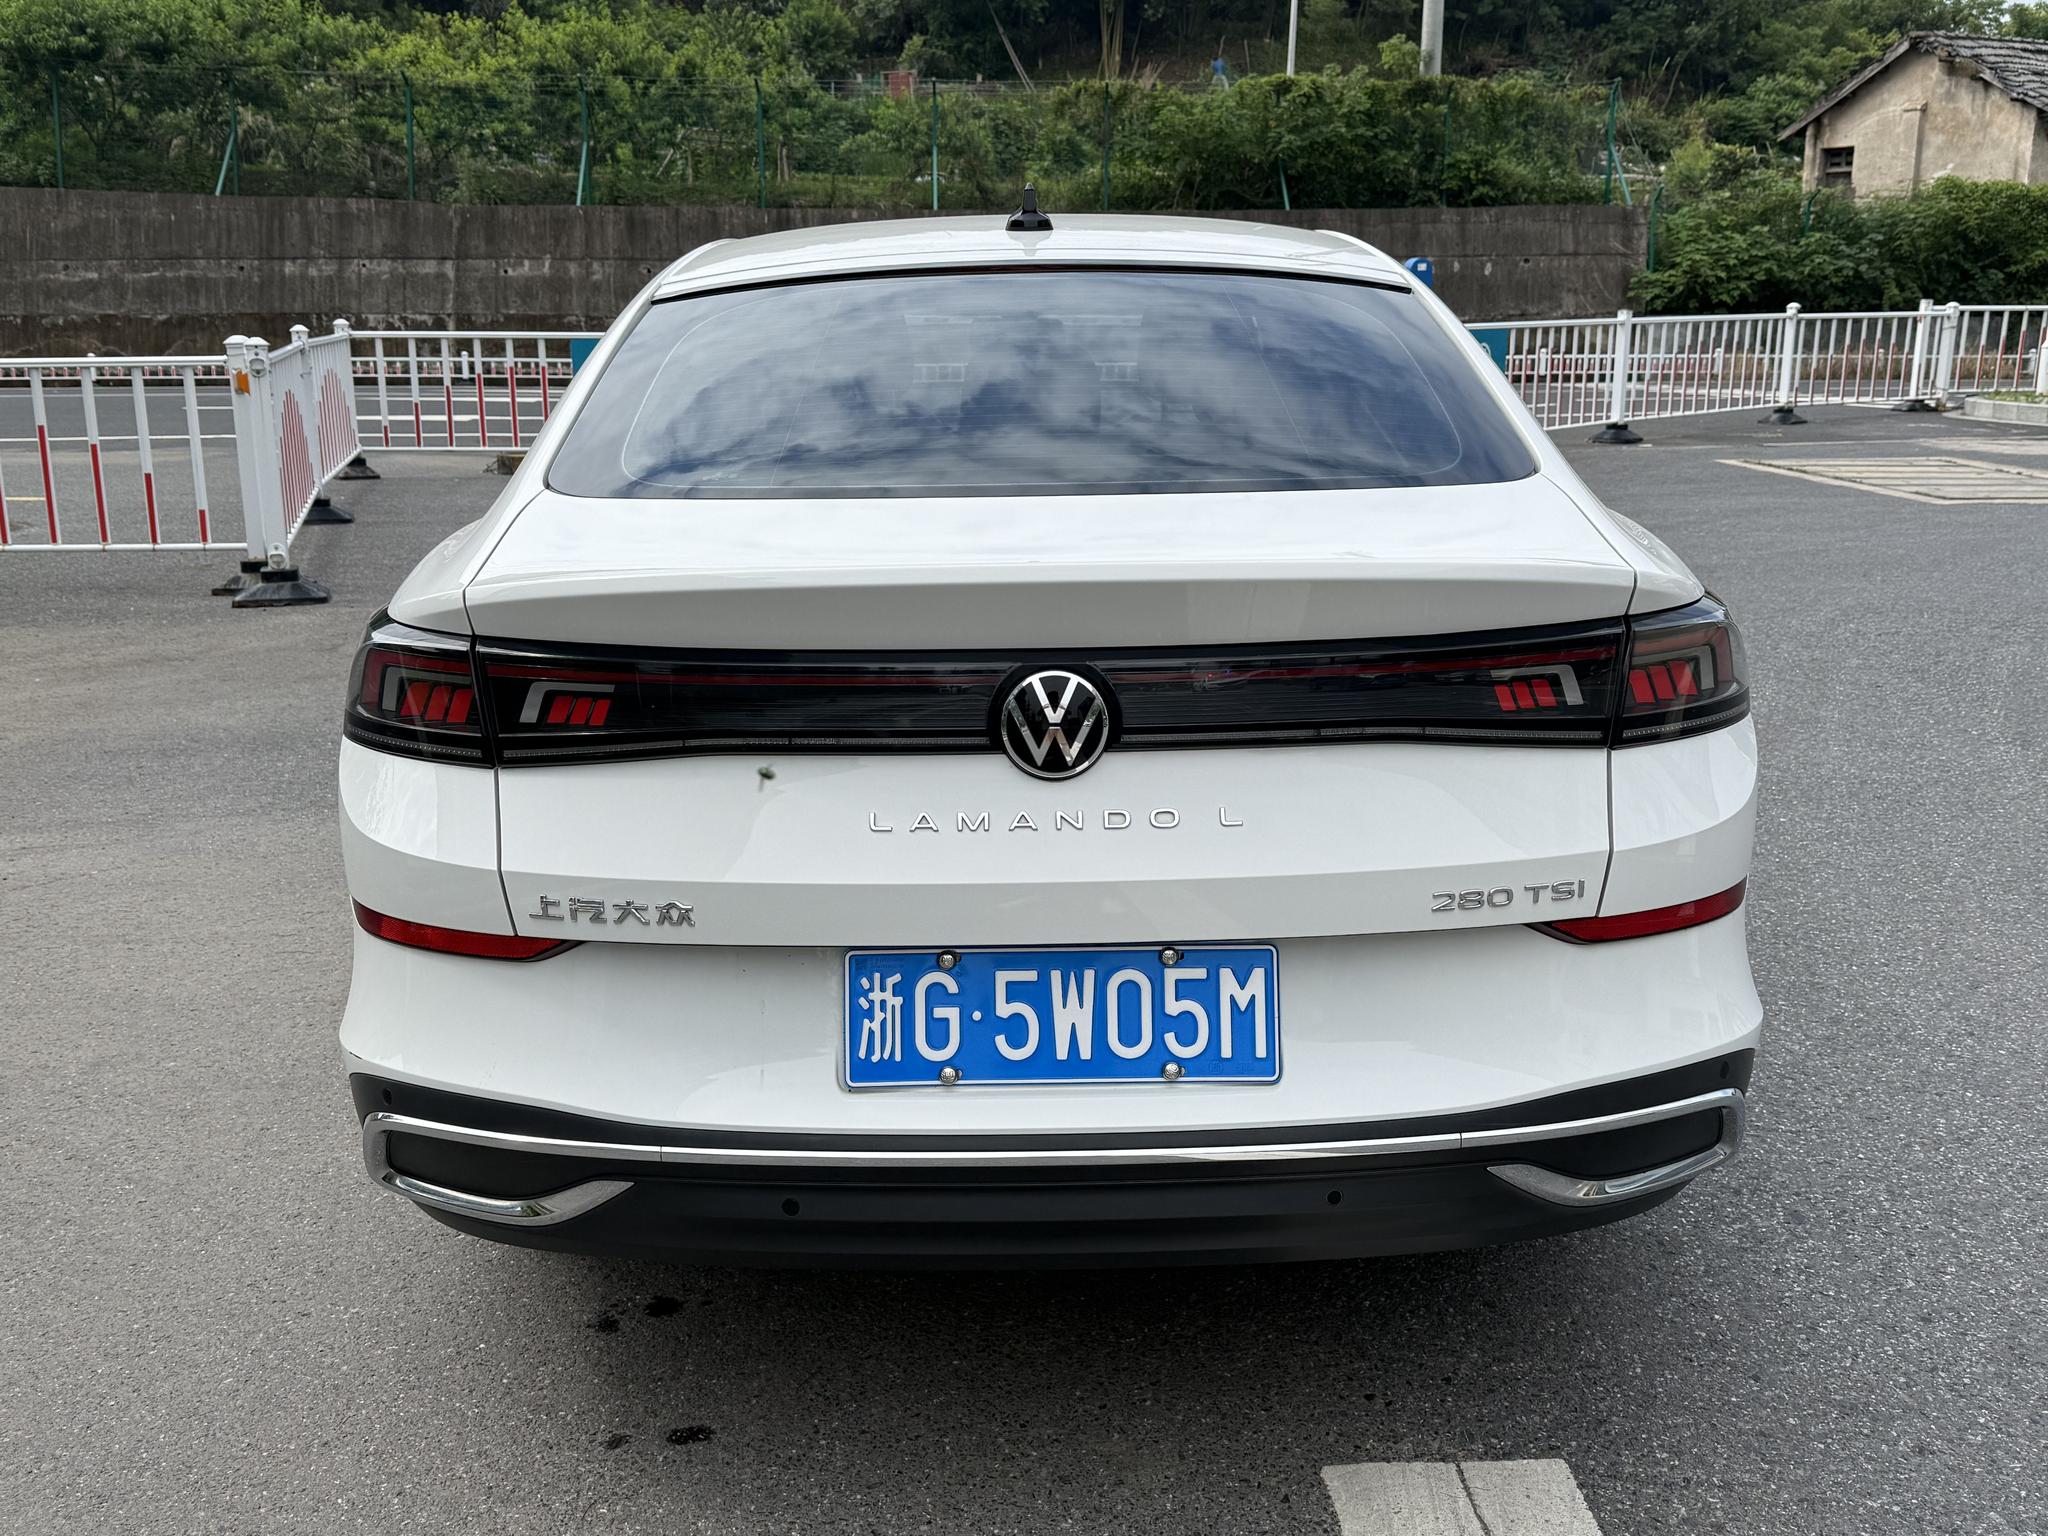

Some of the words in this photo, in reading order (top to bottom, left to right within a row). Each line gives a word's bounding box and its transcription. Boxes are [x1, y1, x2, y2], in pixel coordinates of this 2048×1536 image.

[1004, 672, 1107, 775] VW
[868, 808, 1181, 833] LAMANDO
[1219, 807, 1244, 827] L
[528, 893, 696, 928] 上汽大众
[1431, 886, 1514, 912] 280
[1524, 878, 1586, 904] TSI
